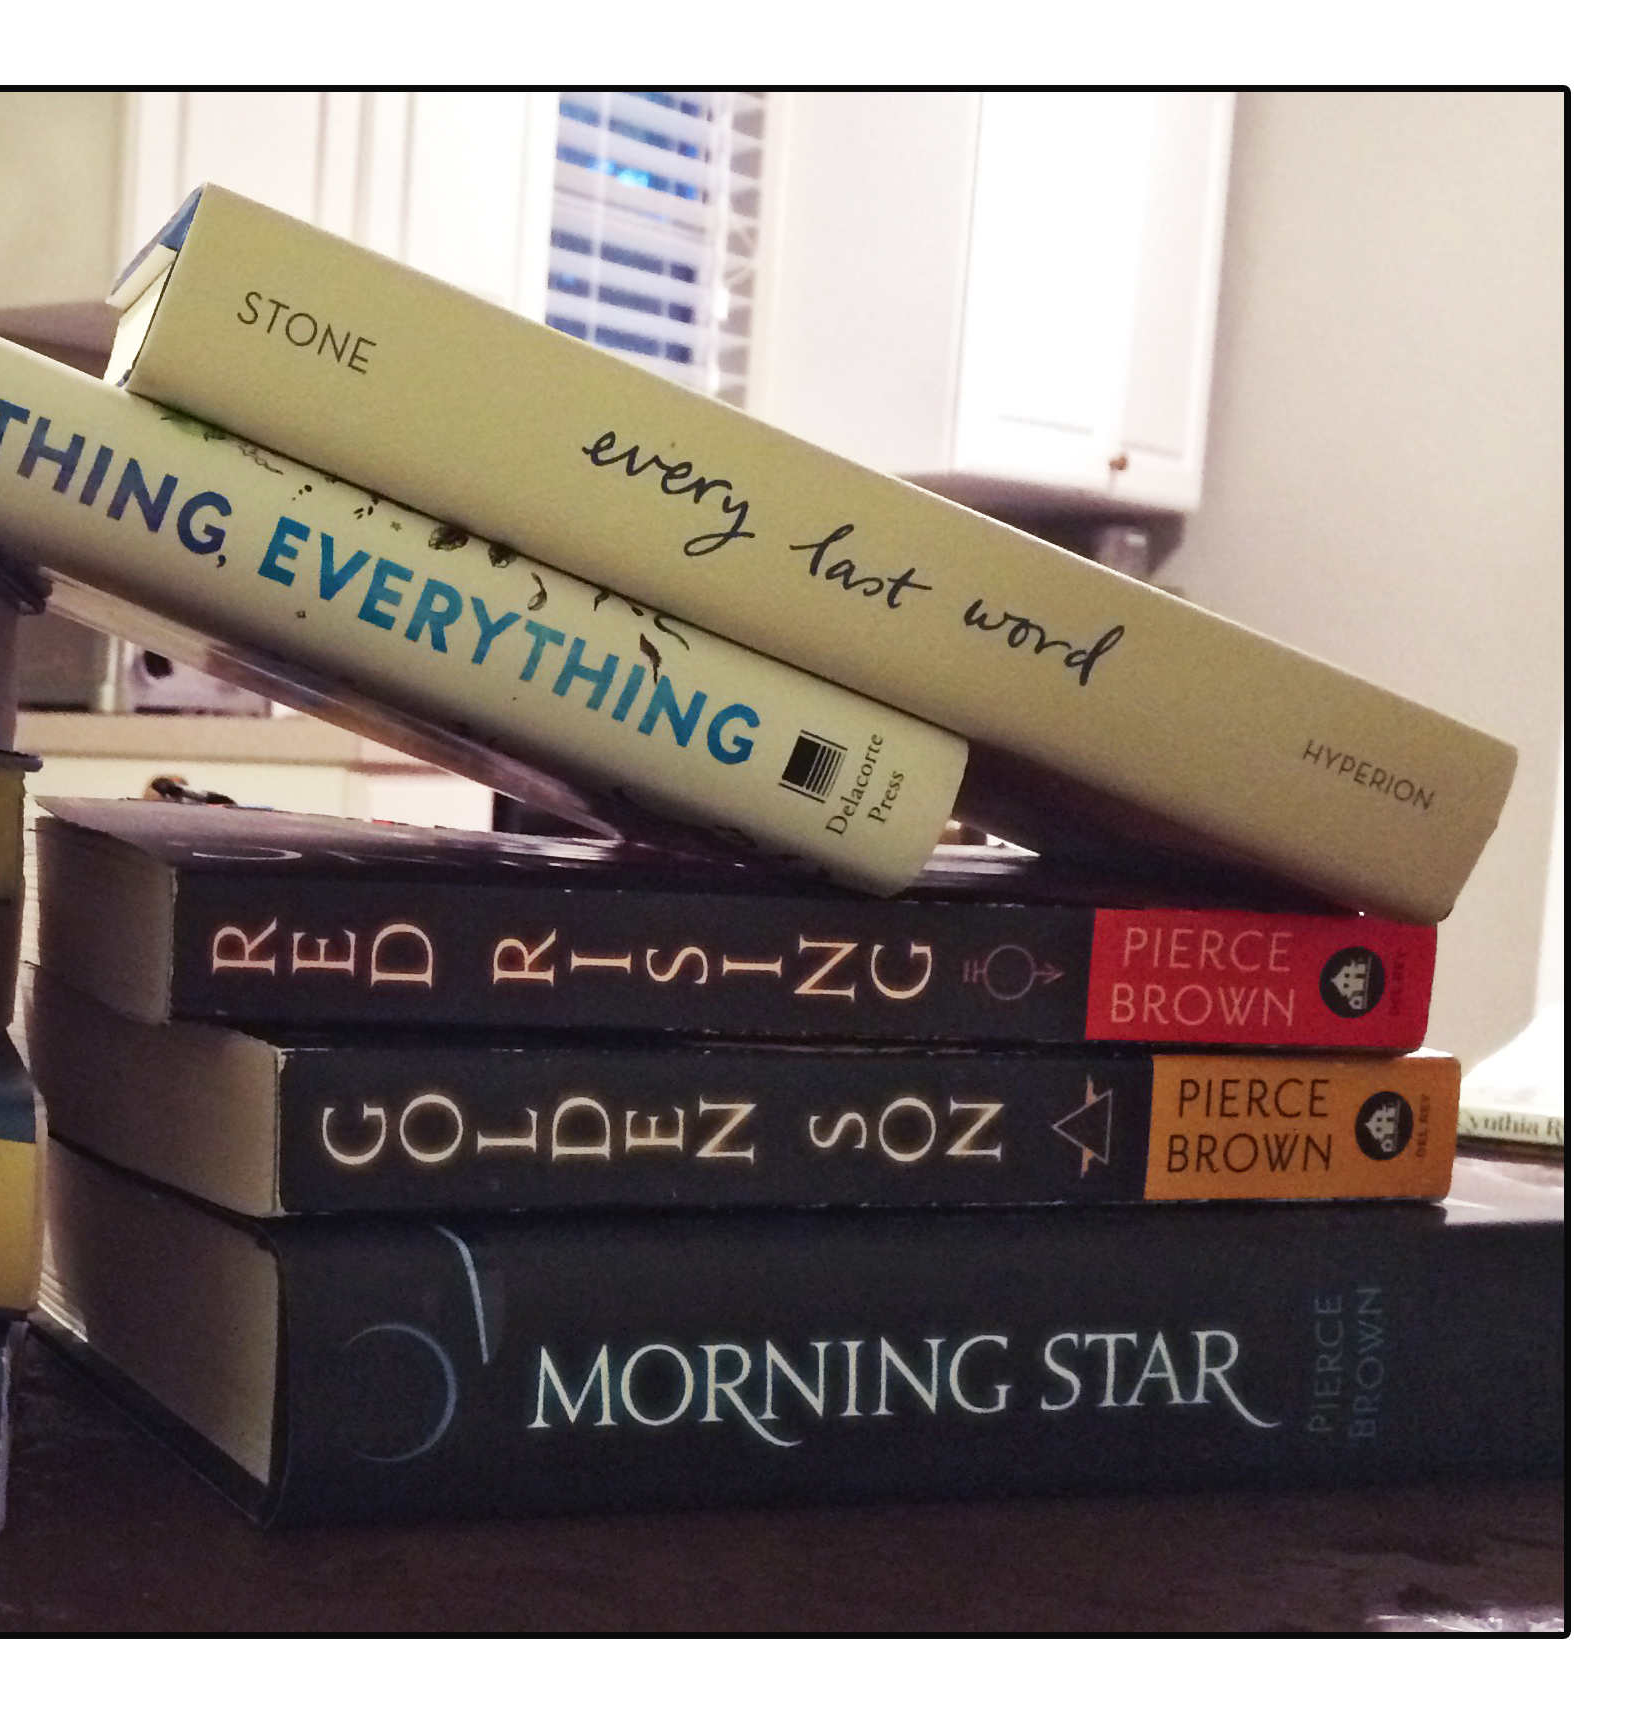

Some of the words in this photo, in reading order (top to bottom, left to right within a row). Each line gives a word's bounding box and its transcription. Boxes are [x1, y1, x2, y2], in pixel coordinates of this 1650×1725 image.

[236, 291, 377, 375] STONE
[582, 430, 755, 556] every
[789, 524, 932, 609] last
[964, 599, 1125, 686] word
[257, 517, 760, 766] EVERYTHING
[827, 731, 883, 836] Delacorte
[867, 769, 905, 825] Press
[1302, 739, 1436, 813] HYPERION
[211, 917, 434, 988] RED
[493, 929, 933, 1002] RISING
[1121, 928, 1292, 974] PIERCE
[1111, 983, 1296, 1028] BROWN
[321, 1093, 757, 1166] GOLDEN
[809, 1096, 1005, 1164] SON
[1177, 1078, 1331, 1120] PIERCE
[1418, 1092, 1431, 1127] REY
[1167, 1133, 1334, 1174] BROWN
[1414, 1129, 1428, 1158] DEL
[526, 1333, 1013, 1448] MORNING
[1041, 1329, 1283, 1429] STAR
[1308, 1295, 1343, 1433] PIERCE
[1349, 1288, 1384, 1437] BROWN
